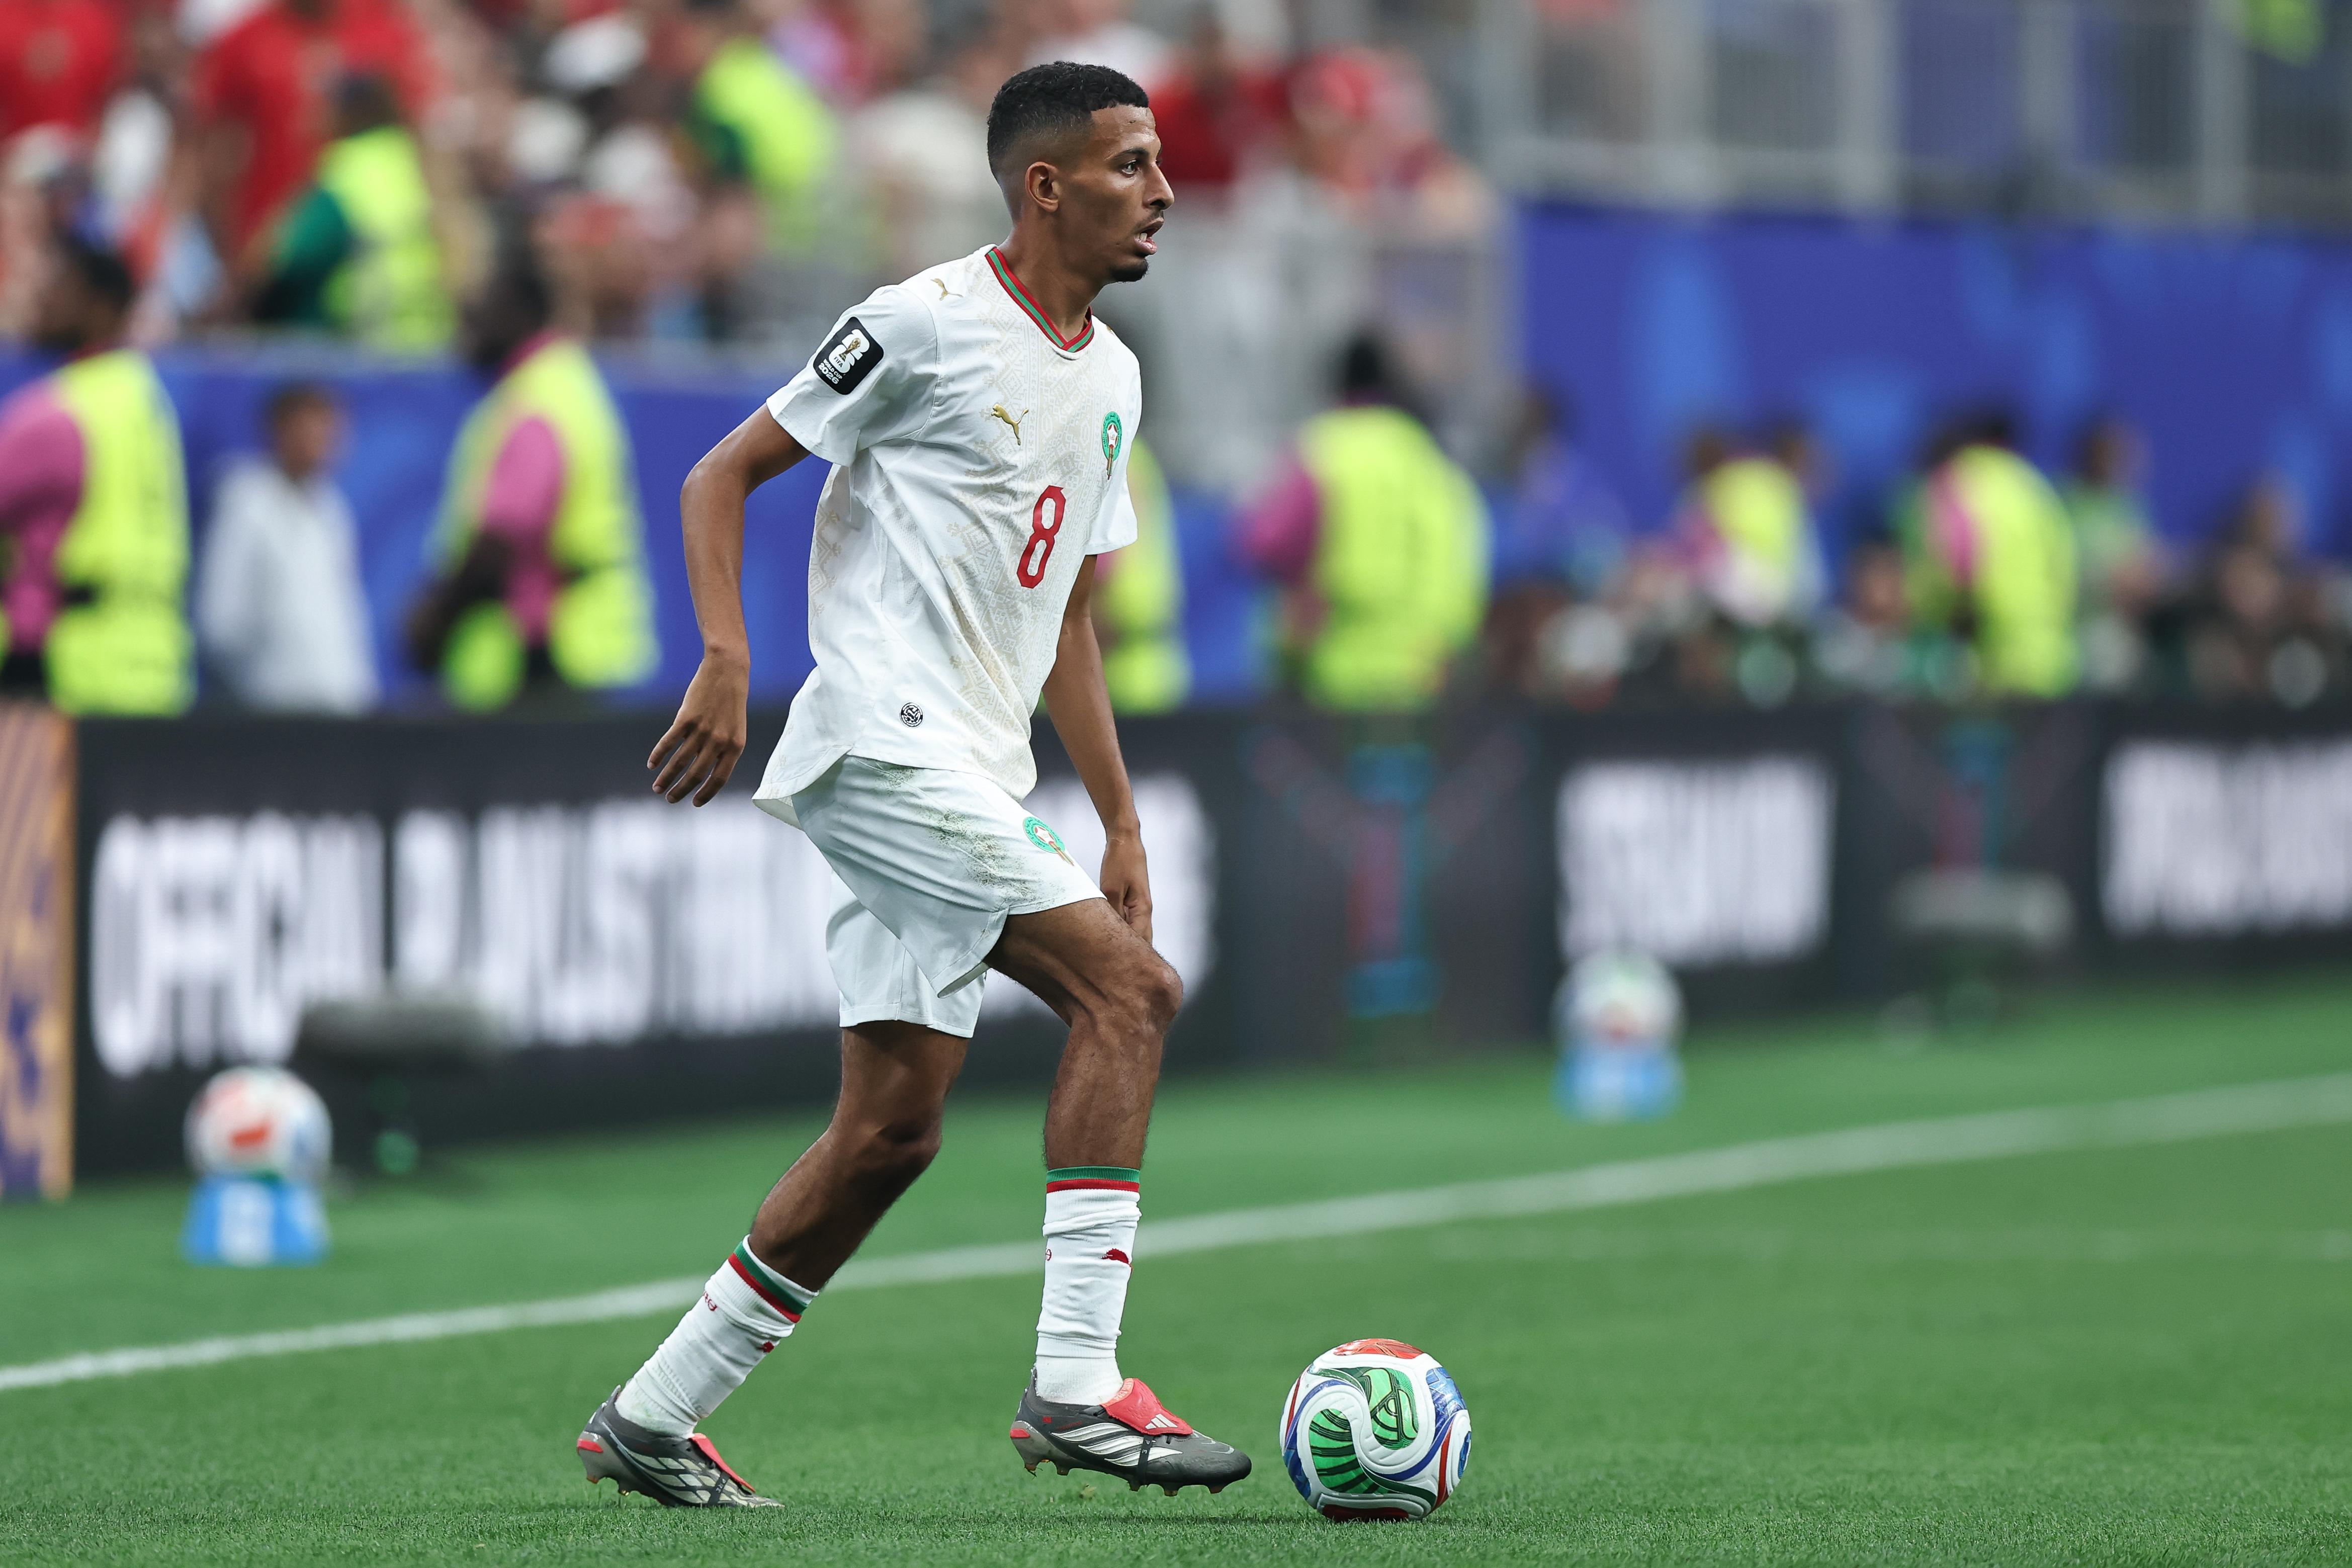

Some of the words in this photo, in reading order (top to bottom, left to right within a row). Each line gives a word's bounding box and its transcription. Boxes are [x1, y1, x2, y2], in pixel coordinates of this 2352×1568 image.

[823, 359, 835, 372] WORLD
[833, 371, 843, 379] CUP
[834, 356, 844, 368] FIFA
[818, 363, 840, 384] 2026
[1016, 485, 1067, 589] 8
